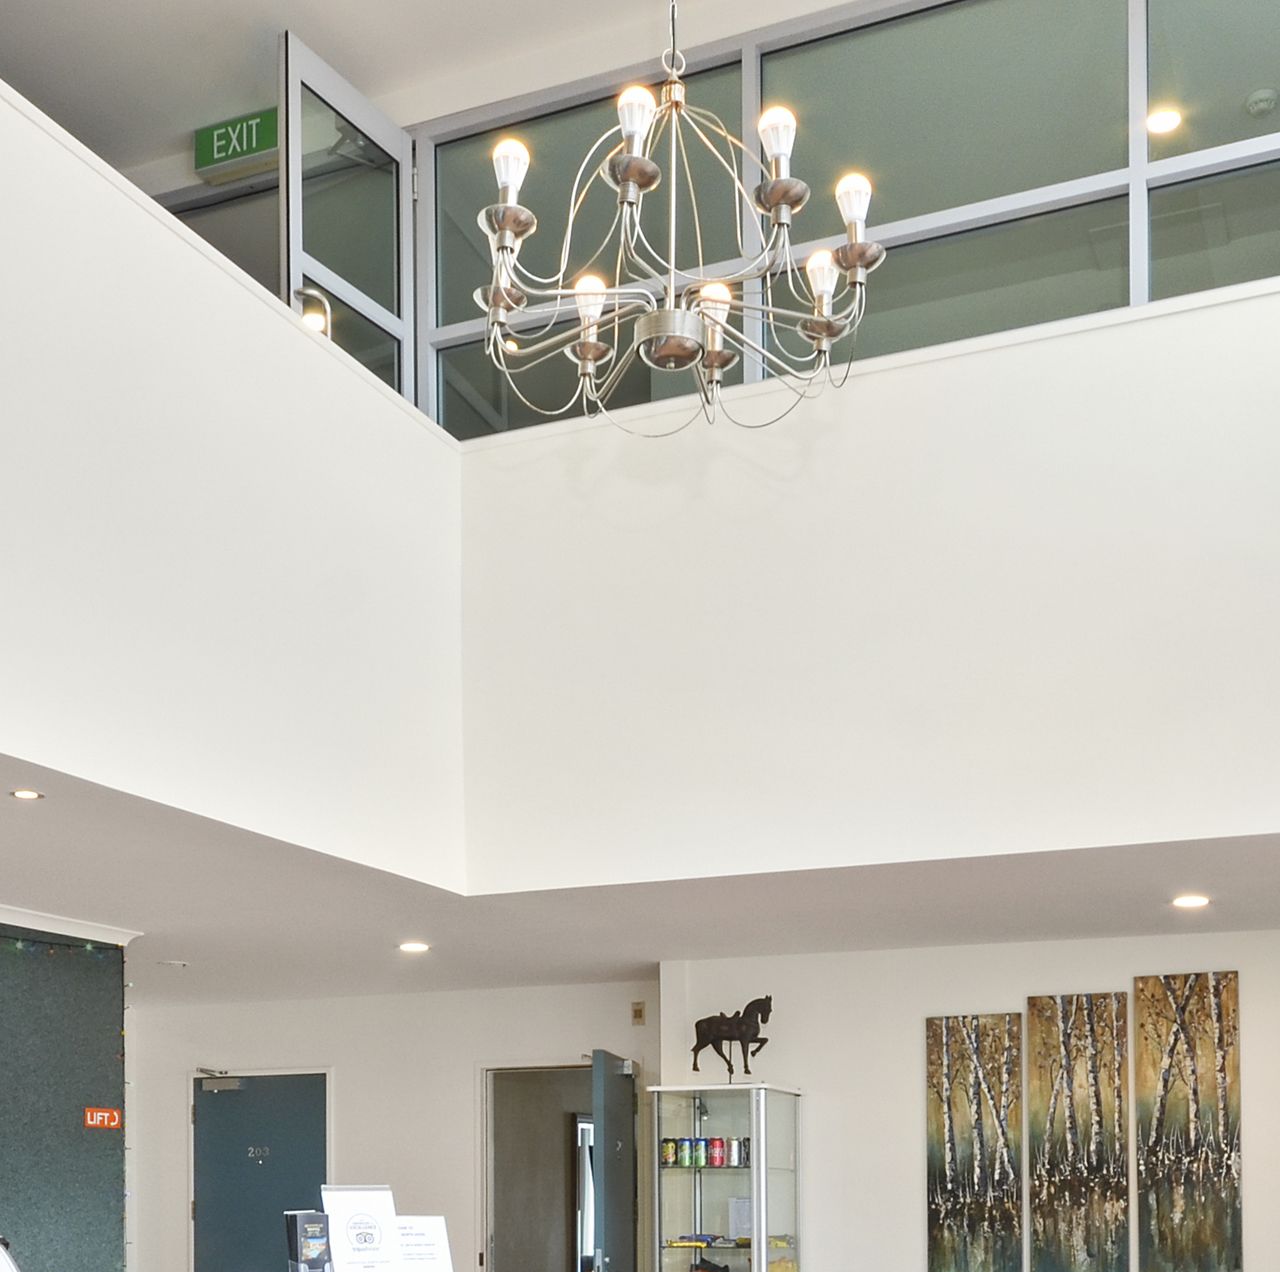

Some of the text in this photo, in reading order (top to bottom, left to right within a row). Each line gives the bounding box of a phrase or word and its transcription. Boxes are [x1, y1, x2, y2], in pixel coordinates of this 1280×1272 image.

[213, 118, 261, 160] EXIT
[87, 1111, 110, 1126] LIFT
[247, 1146, 270, 1157] 203
